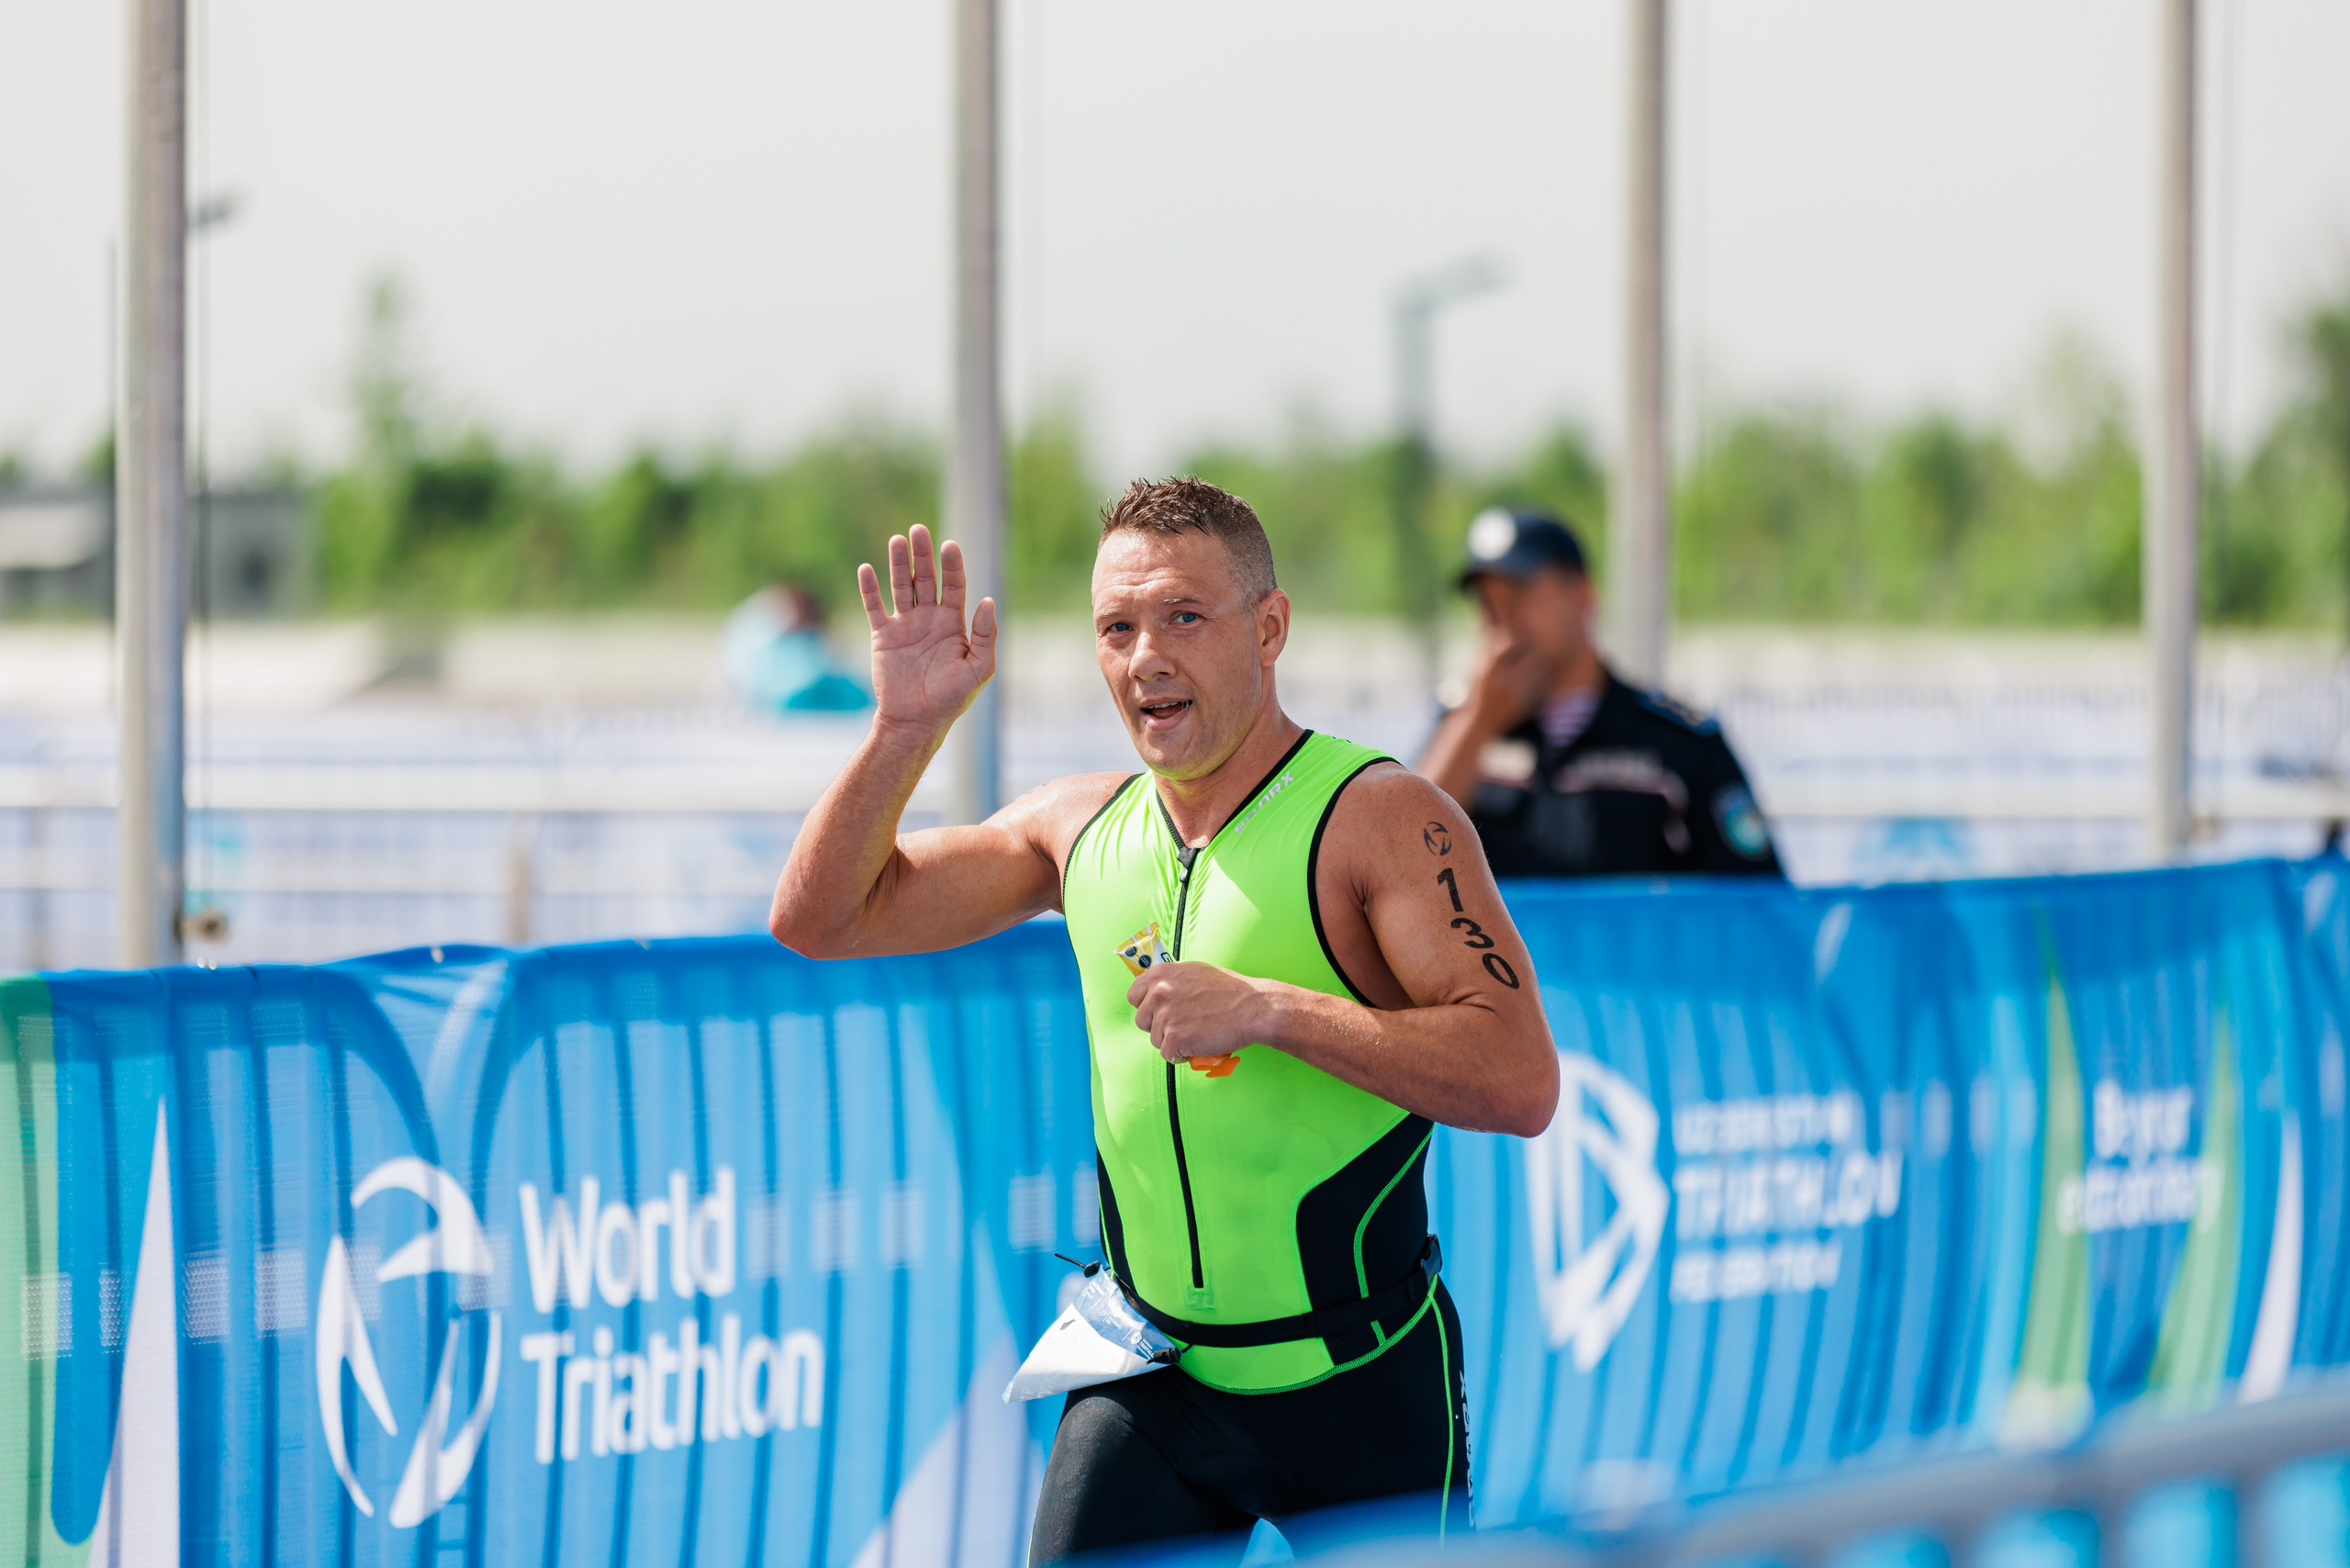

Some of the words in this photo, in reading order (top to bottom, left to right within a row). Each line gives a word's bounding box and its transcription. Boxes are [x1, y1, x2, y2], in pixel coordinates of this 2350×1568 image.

[1437, 867, 1520, 990] 130
[520, 1166, 734, 1314] World
[520, 1314, 823, 1464] Triathlon
